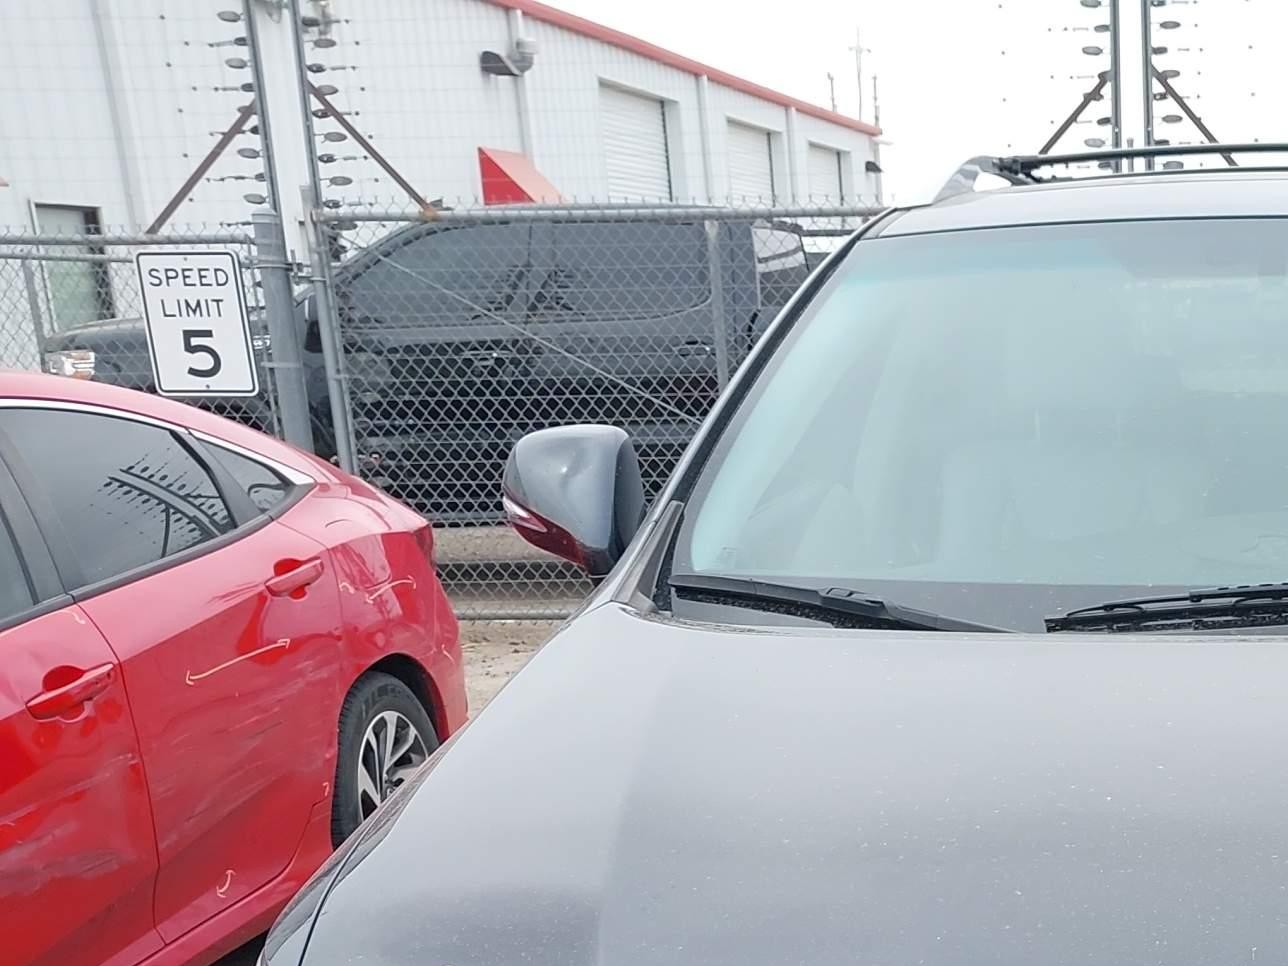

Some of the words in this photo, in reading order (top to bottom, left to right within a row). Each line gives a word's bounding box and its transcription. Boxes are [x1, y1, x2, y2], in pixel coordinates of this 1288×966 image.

[148, 268, 229, 287] SPEED
[160, 299, 224, 318] LIMIT
[182, 329, 222, 378] 5
